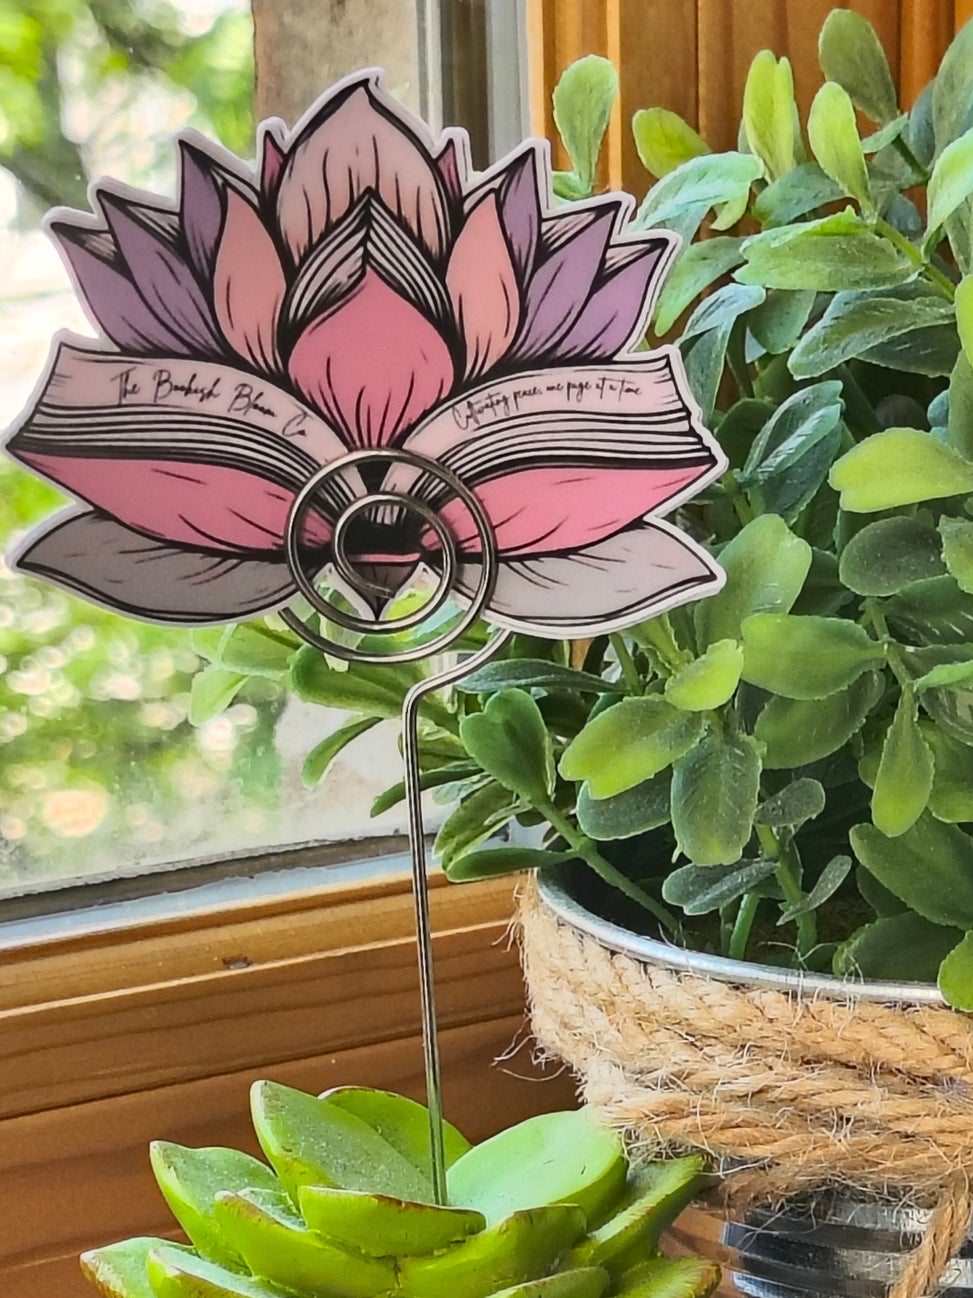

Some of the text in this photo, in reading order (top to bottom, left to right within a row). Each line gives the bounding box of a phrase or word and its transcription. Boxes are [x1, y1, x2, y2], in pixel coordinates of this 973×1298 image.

[110, 367, 141, 404] The
[153, 369, 221, 402] Bookish
[228, 383, 277, 417] Bloom
[567, 381, 592, 402] page
